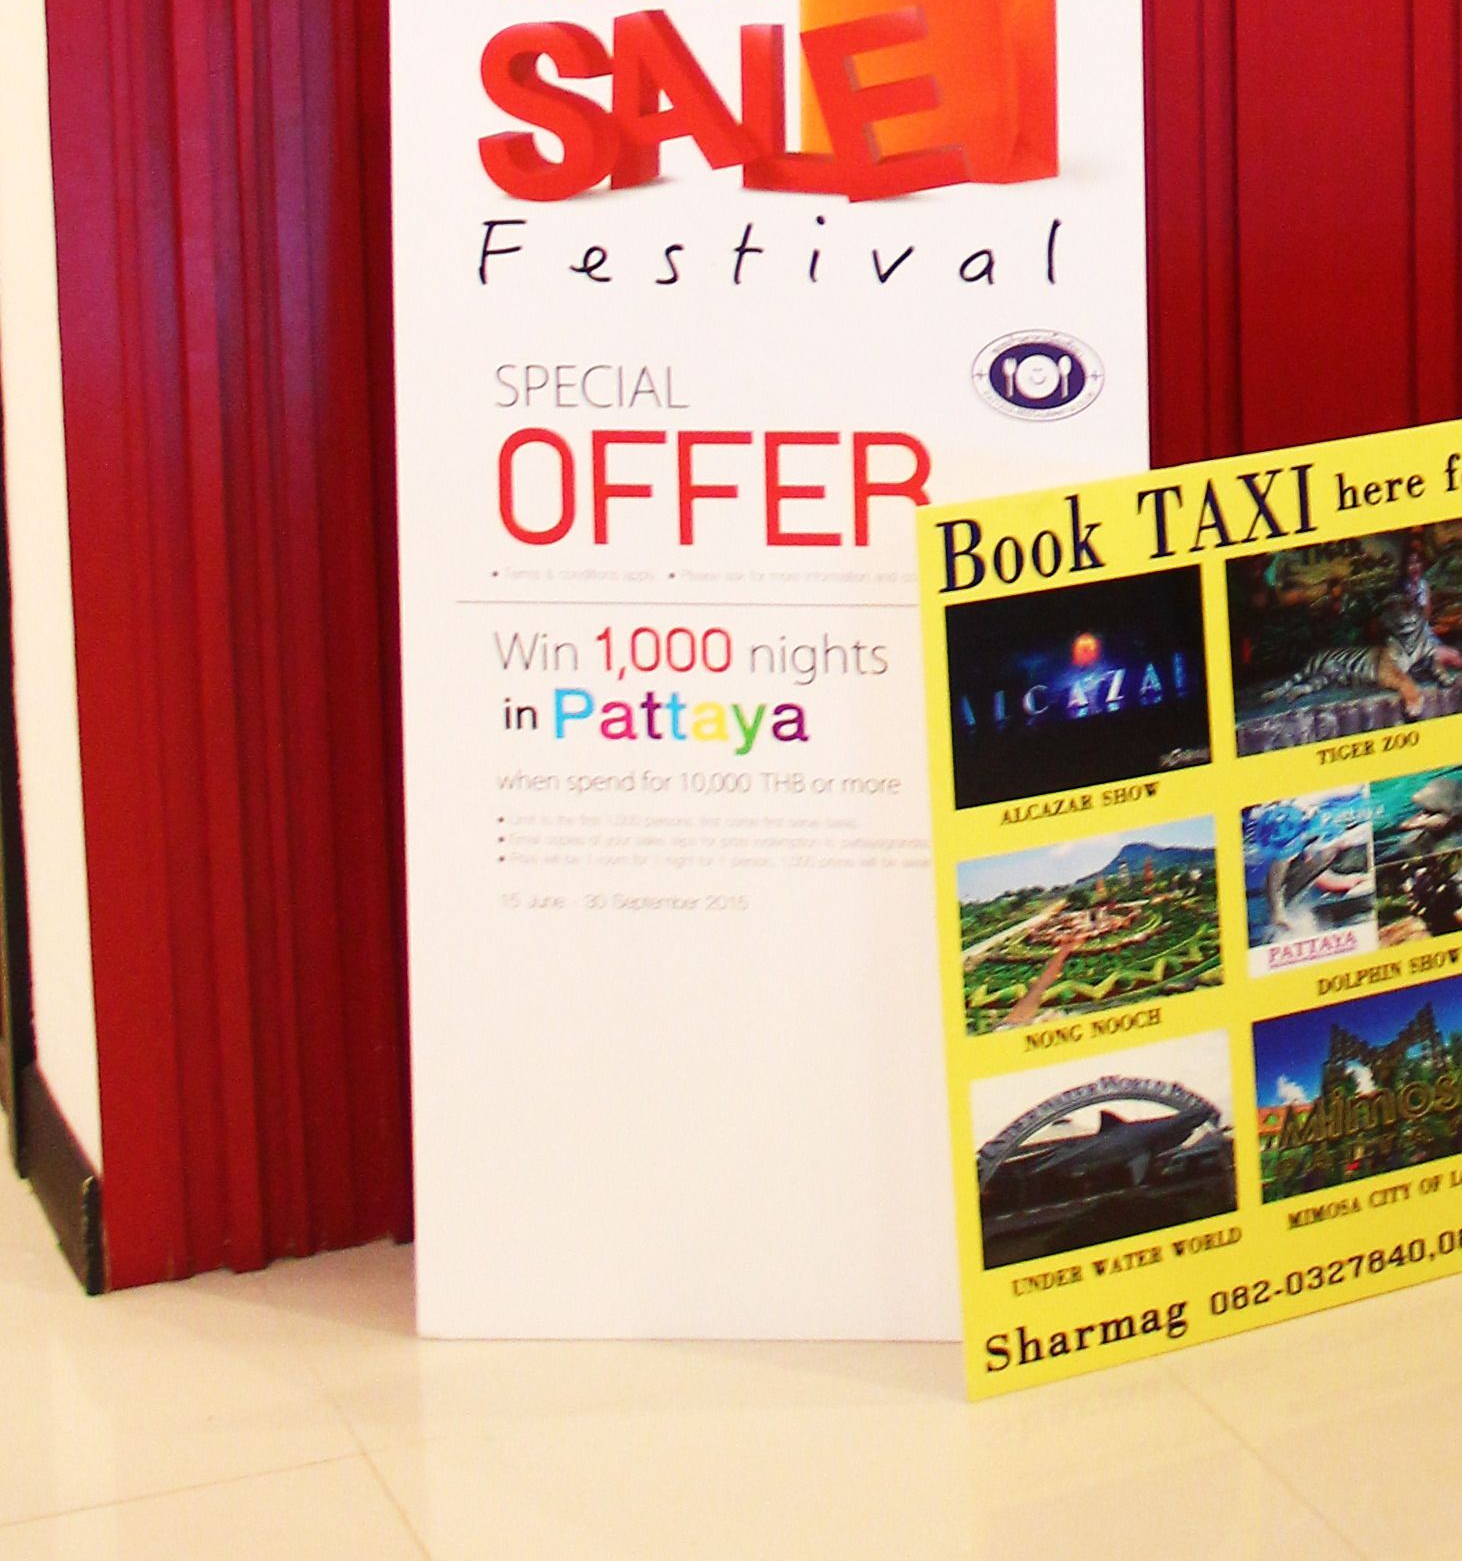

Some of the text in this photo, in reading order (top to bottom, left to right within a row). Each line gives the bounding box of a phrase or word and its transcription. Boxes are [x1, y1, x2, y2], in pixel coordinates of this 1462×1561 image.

[477, 5, 974, 203] SALE
[478, 216, 1061, 286] Festival
[495, 363, 689, 410] SPECIAL
[497, 427, 932, 547] OFFER
[934, 494, 1105, 595] Book
[1137, 463, 1318, 560] TAXI
[1335, 471, 1425, 511] here
[493, 625, 889, 687] Win 1,000 nights
[504, 687, 810, 756] in Pattaya
[1316, 730, 1421, 766] TIGER ZOO
[496, 771, 901, 800] when spend for 10,000 THB or more
[1000, 780, 1161, 826] ALCAZAR SHOW
[1316, 945, 1462, 997] DOLPHIN SHOW
[1024, 1006, 1163, 1053] NONG NOOCH
[1287, 1195, 1362, 1231] MIMOSA
[1368, 1181, 1411, 1209] CITY
[1011, 1226, 1243, 1298] UNDER WATER WORLD
[984, 1299, 1189, 1374] Sharmag
